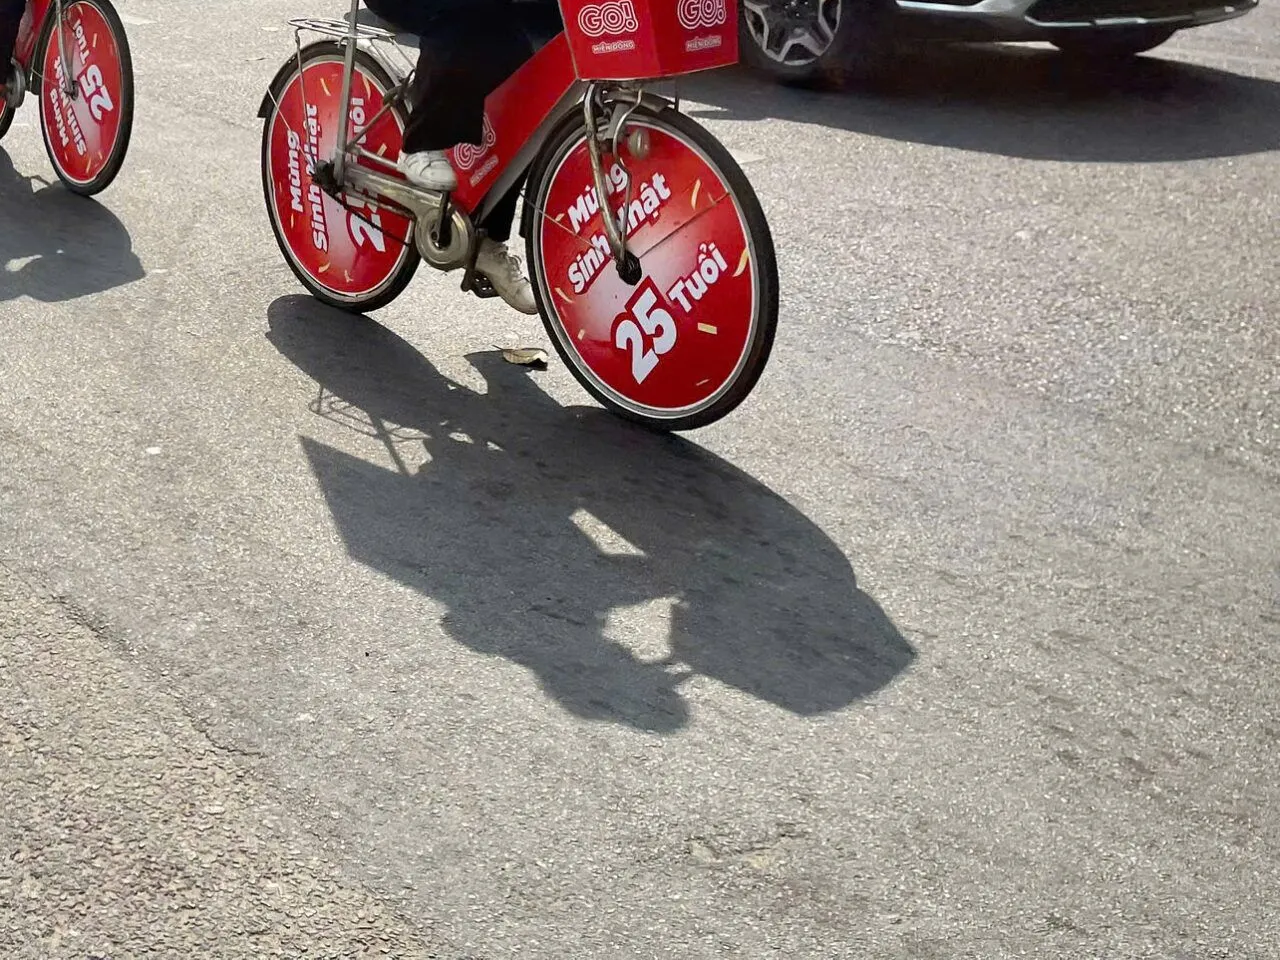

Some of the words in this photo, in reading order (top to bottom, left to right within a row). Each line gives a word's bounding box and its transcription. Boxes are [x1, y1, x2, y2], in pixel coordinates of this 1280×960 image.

[578, 0, 638, 37] GO!
[80, 64, 115, 121] 25
[287, 129, 304, 213] Mừng
[306, 185, 329, 253] Sinh
[567, 234, 612, 294] Sinh
[615, 286, 678, 385] 25
[668, 242, 729, 314] Tuổi
